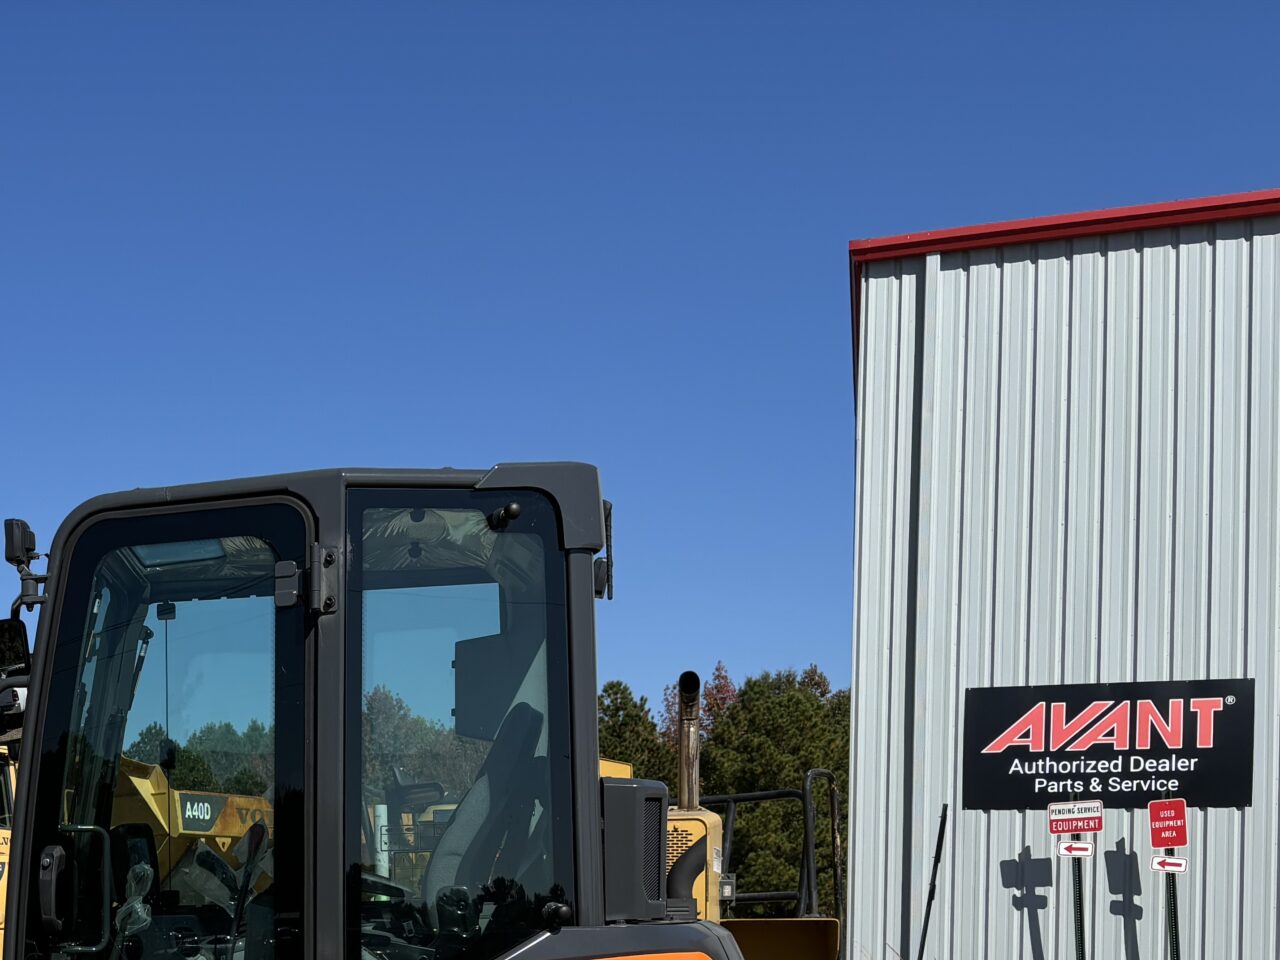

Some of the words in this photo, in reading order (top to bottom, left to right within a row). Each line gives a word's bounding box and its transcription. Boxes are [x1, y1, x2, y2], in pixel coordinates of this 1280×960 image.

[1008, 755, 1123, 775] Authorized
[1130, 754, 1199, 773] Dealer
[1034, 778, 1084, 793] Parts
[1089, 777, 1103, 792] &
[1108, 775, 1179, 792] Service
[185, 801, 211, 820] A40D
[1050, 806, 1075, 816] PENDING
[1076, 805, 1100, 815] SERVICE
[1052, 818, 1099, 831] EQUIPMENT
[1151, 819, 1184, 829] EQUIPMENT
